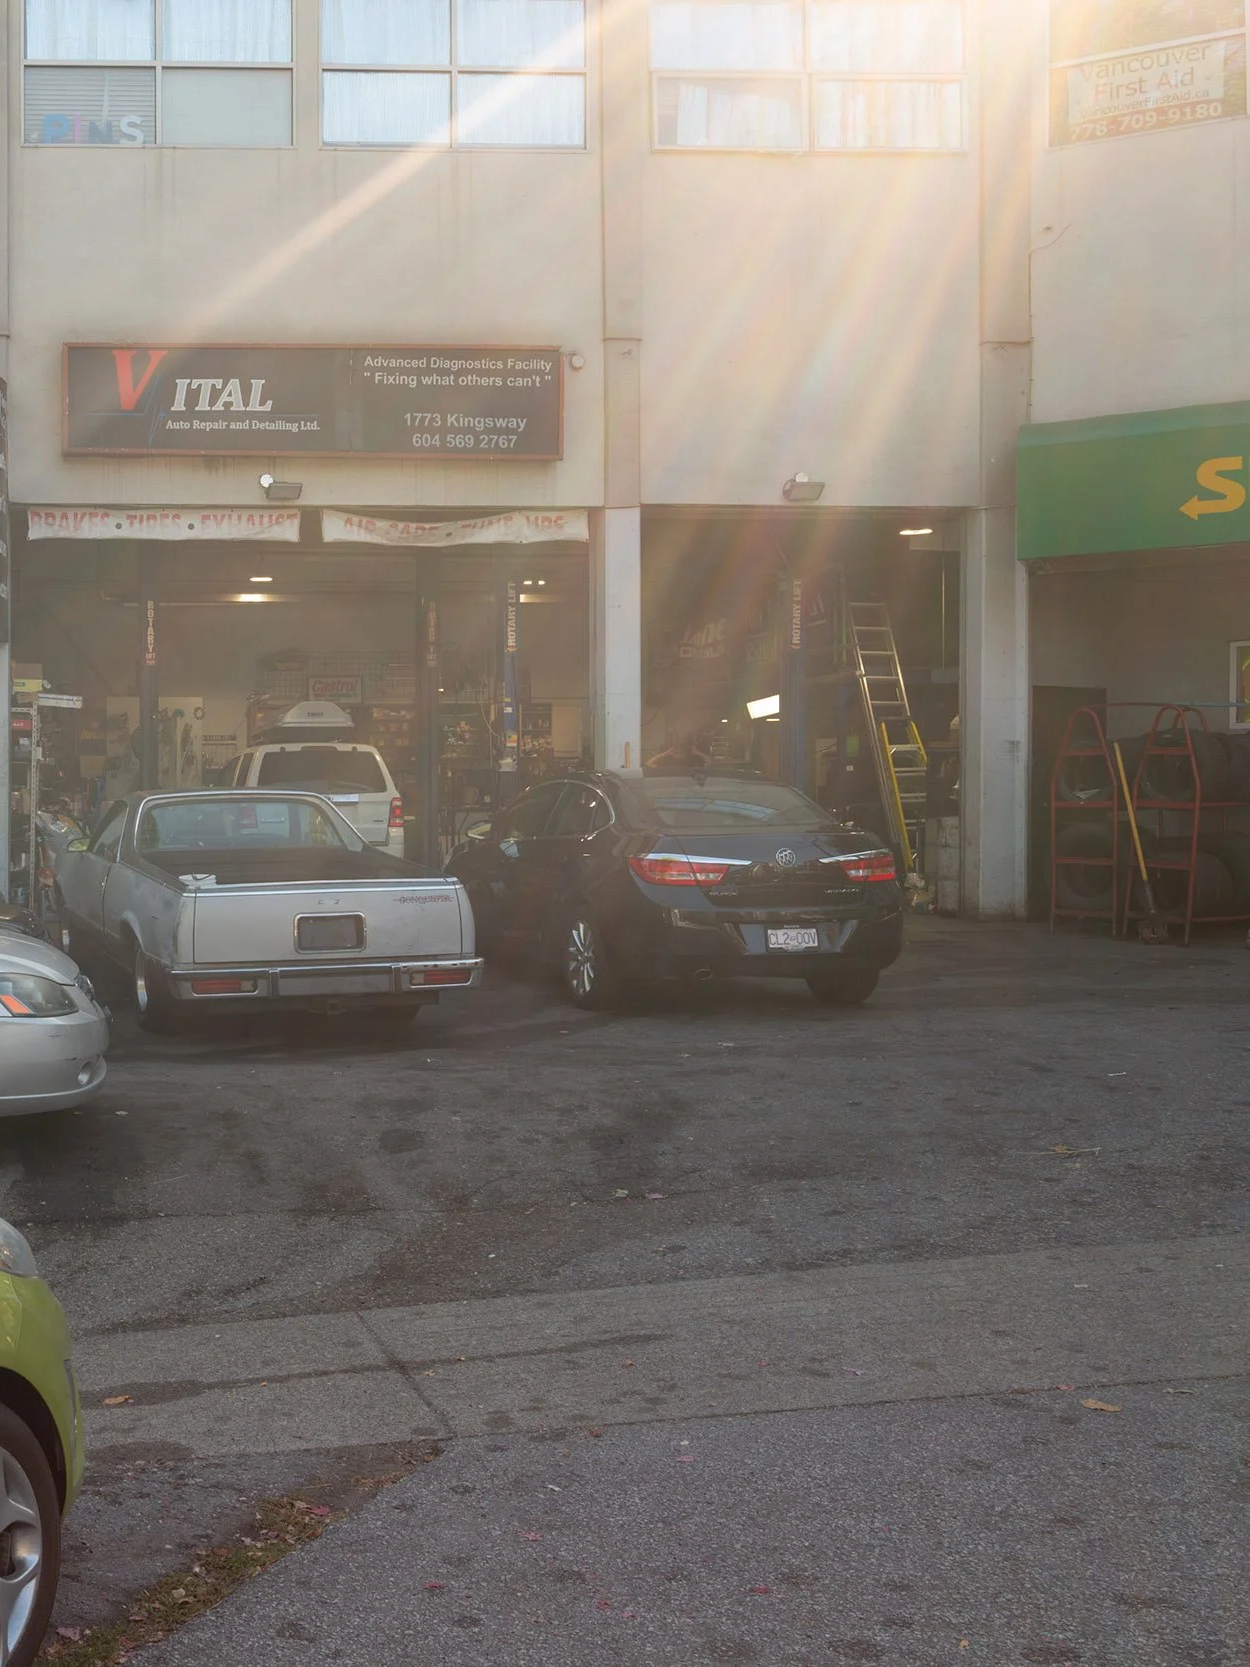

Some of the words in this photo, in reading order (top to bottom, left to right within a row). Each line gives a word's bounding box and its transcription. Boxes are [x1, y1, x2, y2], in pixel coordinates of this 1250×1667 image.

[1078, 44, 1211, 83] Vancouver
[1094, 76, 1147, 102] First
[1157, 67, 1195, 90] Aid
[1070, 102, 1223, 141] 778-709-9180
[364, 355, 427, 368] Advanced
[430, 357, 504, 371] Diagnostics
[507, 358, 552, 373] Facility
[375, 372, 417, 388] Fixing
[421, 374, 455, 386] what
[458, 374, 503, 387] others
[507, 375, 541, 387] can't
[166, 420, 190, 430] Auto
[192, 420, 228, 432] Repair
[230, 420, 250, 430] and
[251, 421, 299, 432] Detailing
[300, 421, 321, 431] Ltd.
[404, 413, 442, 427] 1773
[447, 413, 527, 432] Kingsway
[412, 434, 440, 447] 604
[446, 435, 475, 448] 569
[479, 435, 518, 449] 2767
[507, 605, 516, 647] ROTARY
[792, 603, 801, 645] ROTARY
[312, 679, 359, 693] Castrol
